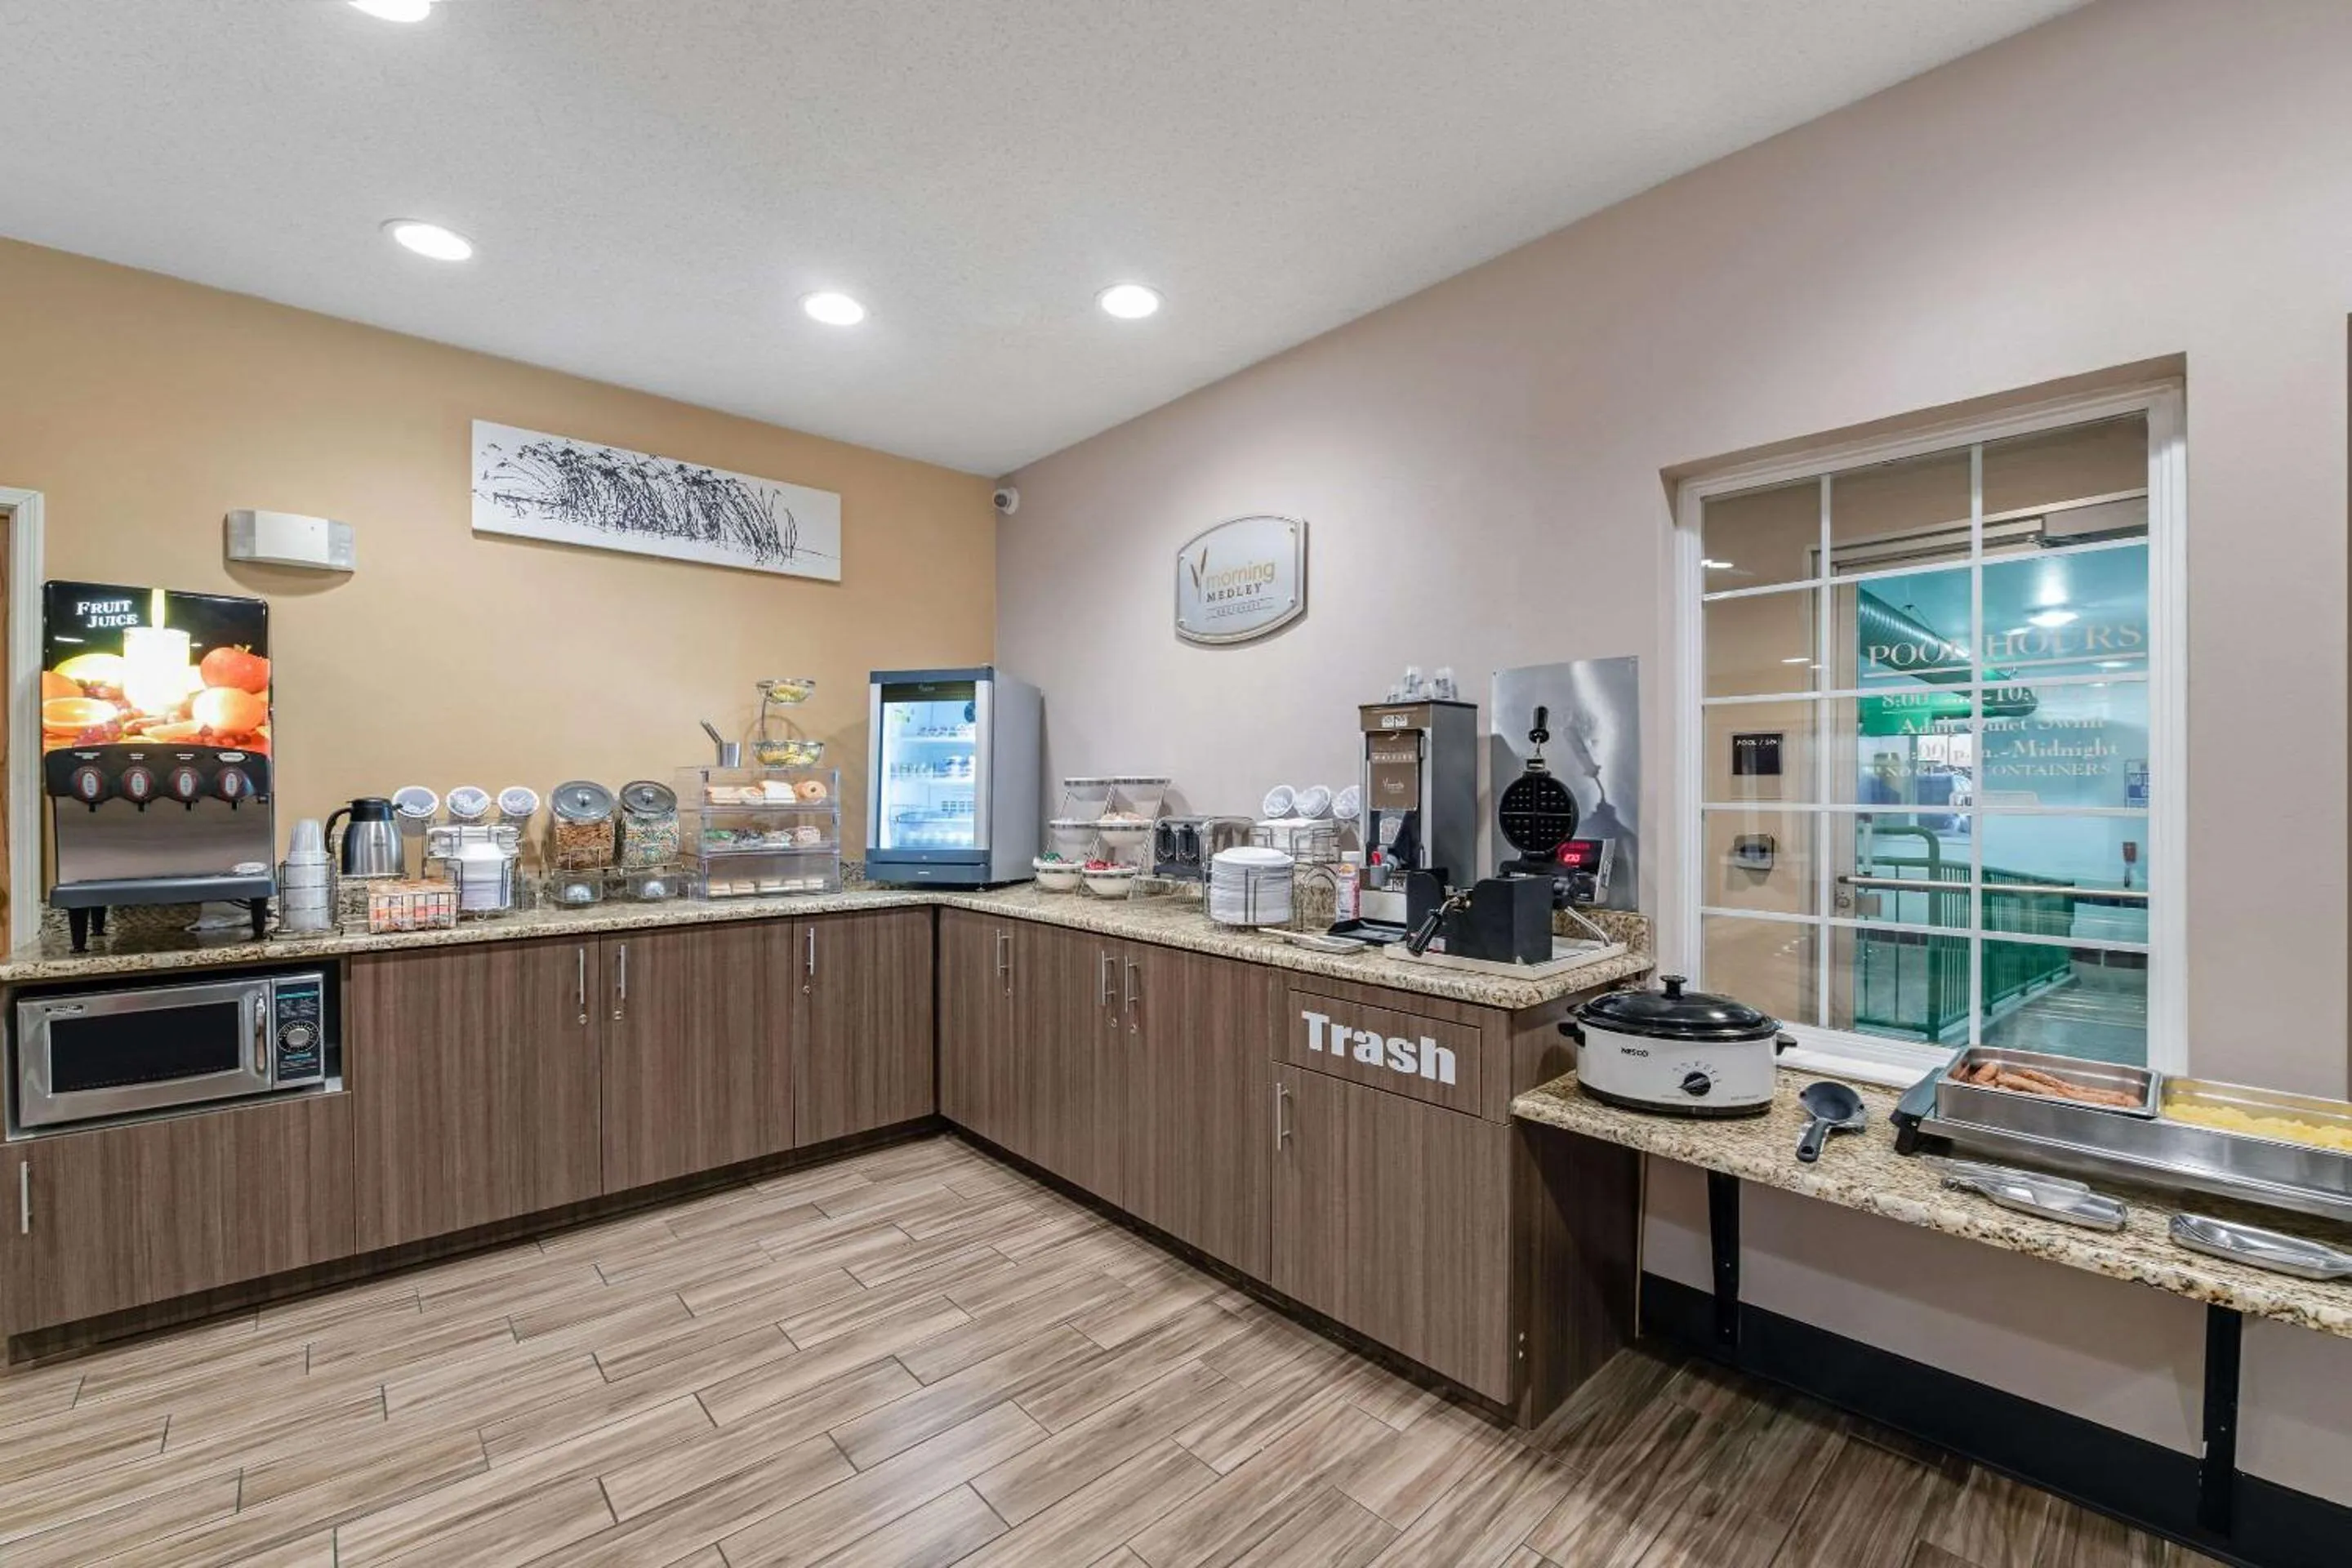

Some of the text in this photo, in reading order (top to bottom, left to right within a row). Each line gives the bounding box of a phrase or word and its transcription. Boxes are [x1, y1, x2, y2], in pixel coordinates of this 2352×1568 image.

[1206, 560, 1275, 590] morning
[1206, 582, 1262, 603] MEDLEY
[75, 600, 132, 615] FRUIT
[87, 613, 139, 628] JUICE
[1869, 640, 1972, 667] POOL
[1981, 763, 2111, 777] ONTAINERS
[1301, 1010, 1456, 1086] Trash
